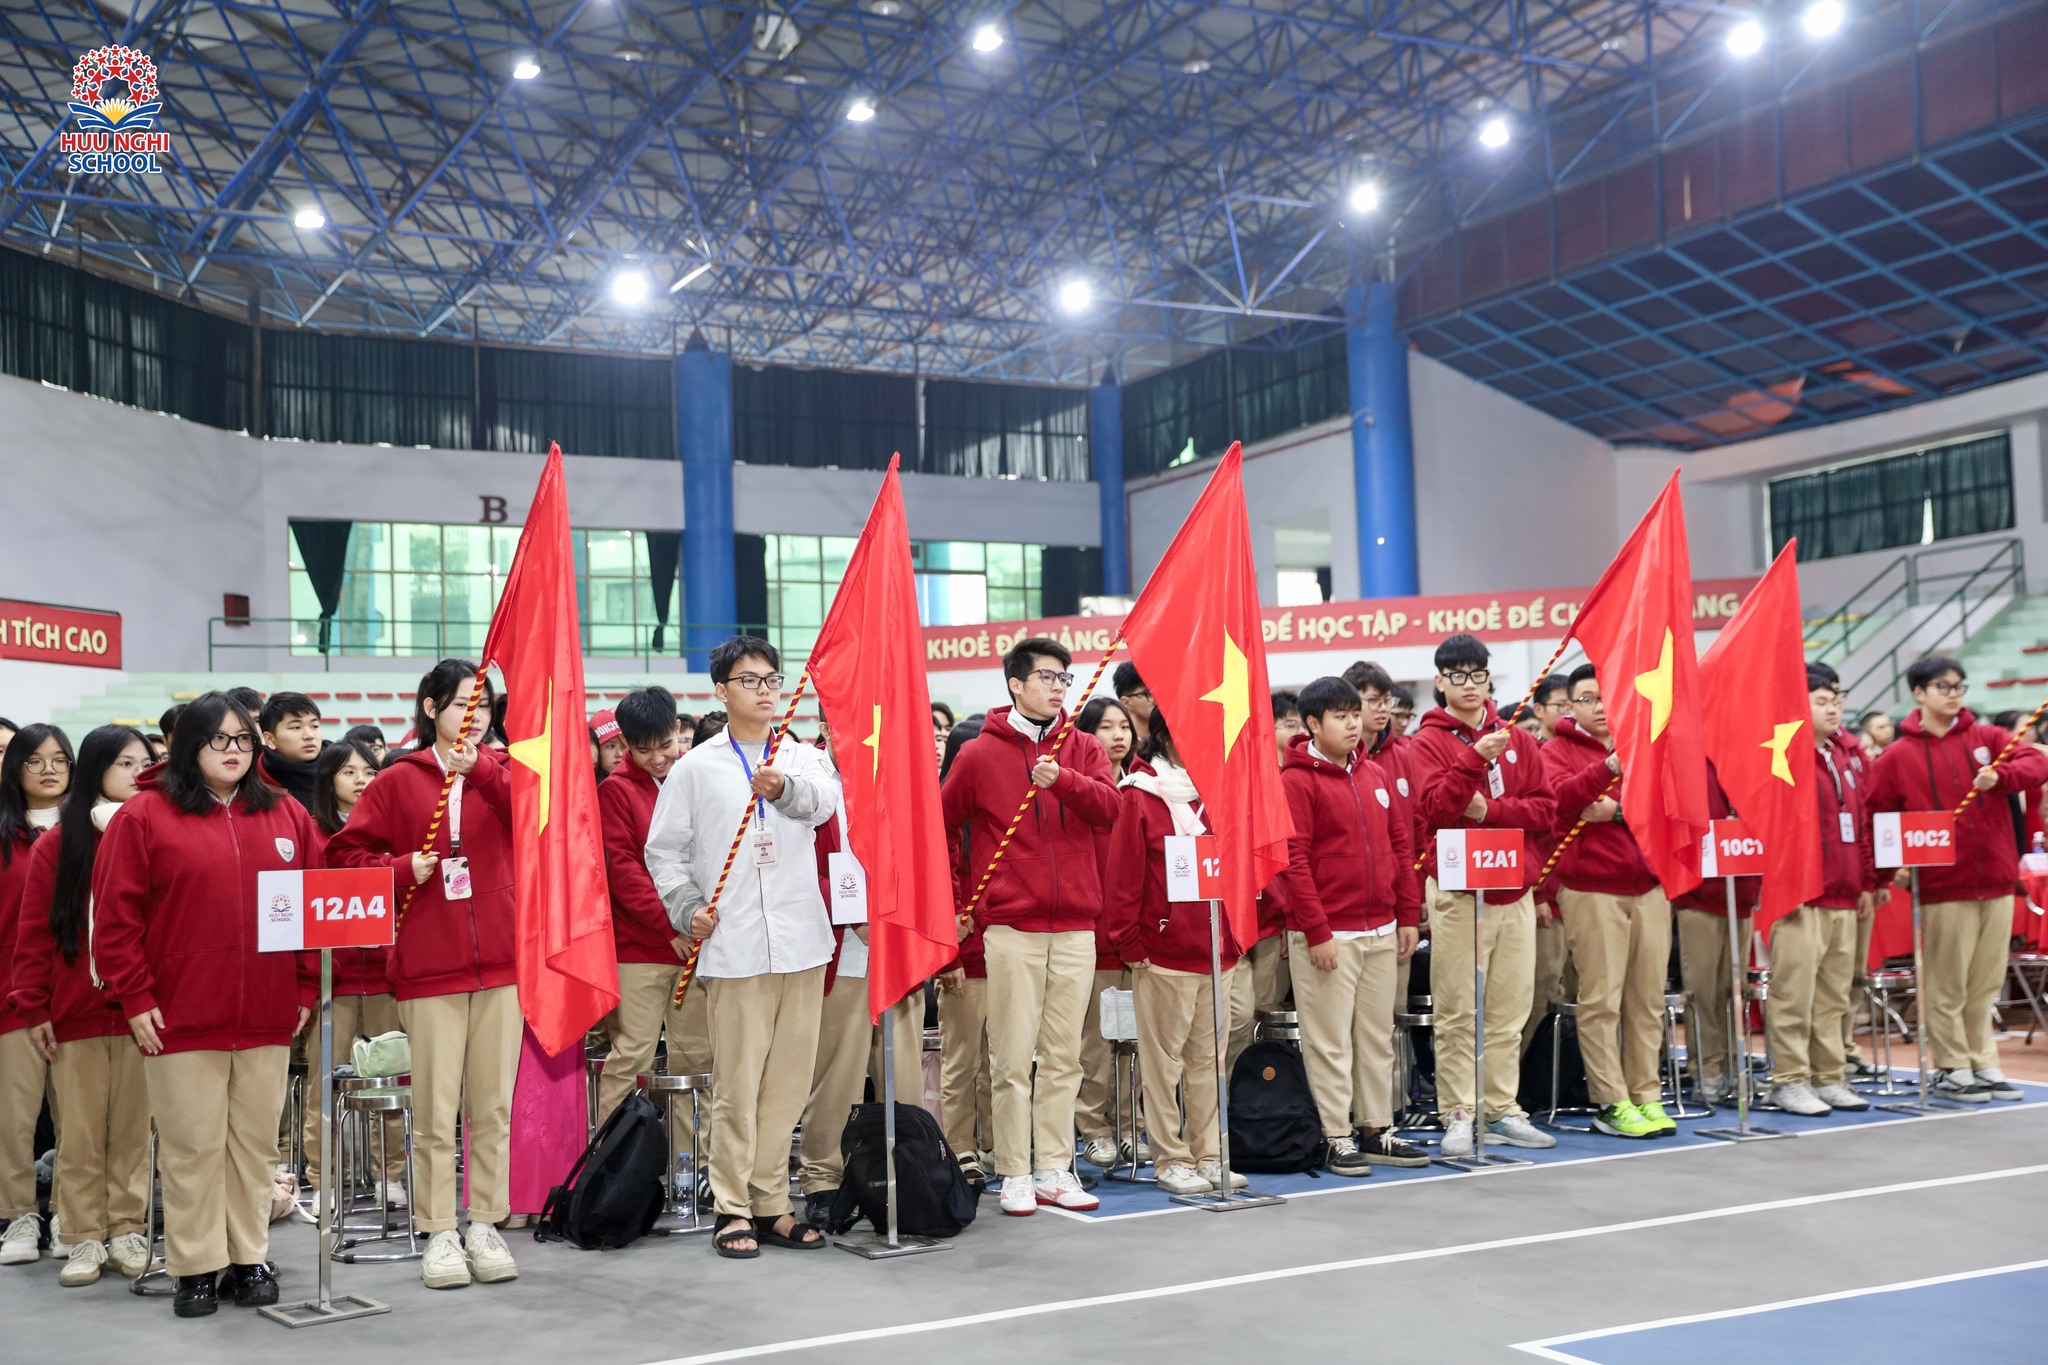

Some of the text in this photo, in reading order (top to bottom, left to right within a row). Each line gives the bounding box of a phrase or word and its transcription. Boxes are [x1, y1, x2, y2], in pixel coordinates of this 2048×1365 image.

[479, 496, 508, 523] B
[11, 616, 60, 650] TÍCH
[65, 626, 108, 655] CAO
[1035, 625, 1110, 651] ẢNG
[1298, 616, 1354, 644] HỌC
[1357, 608, 1408, 642] TẬP
[1720, 838, 1764, 857] 10C1
[1904, 829, 1951, 847] 10C2
[1472, 850, 1517, 868] 12A1
[311, 895, 386, 921] 12A4
